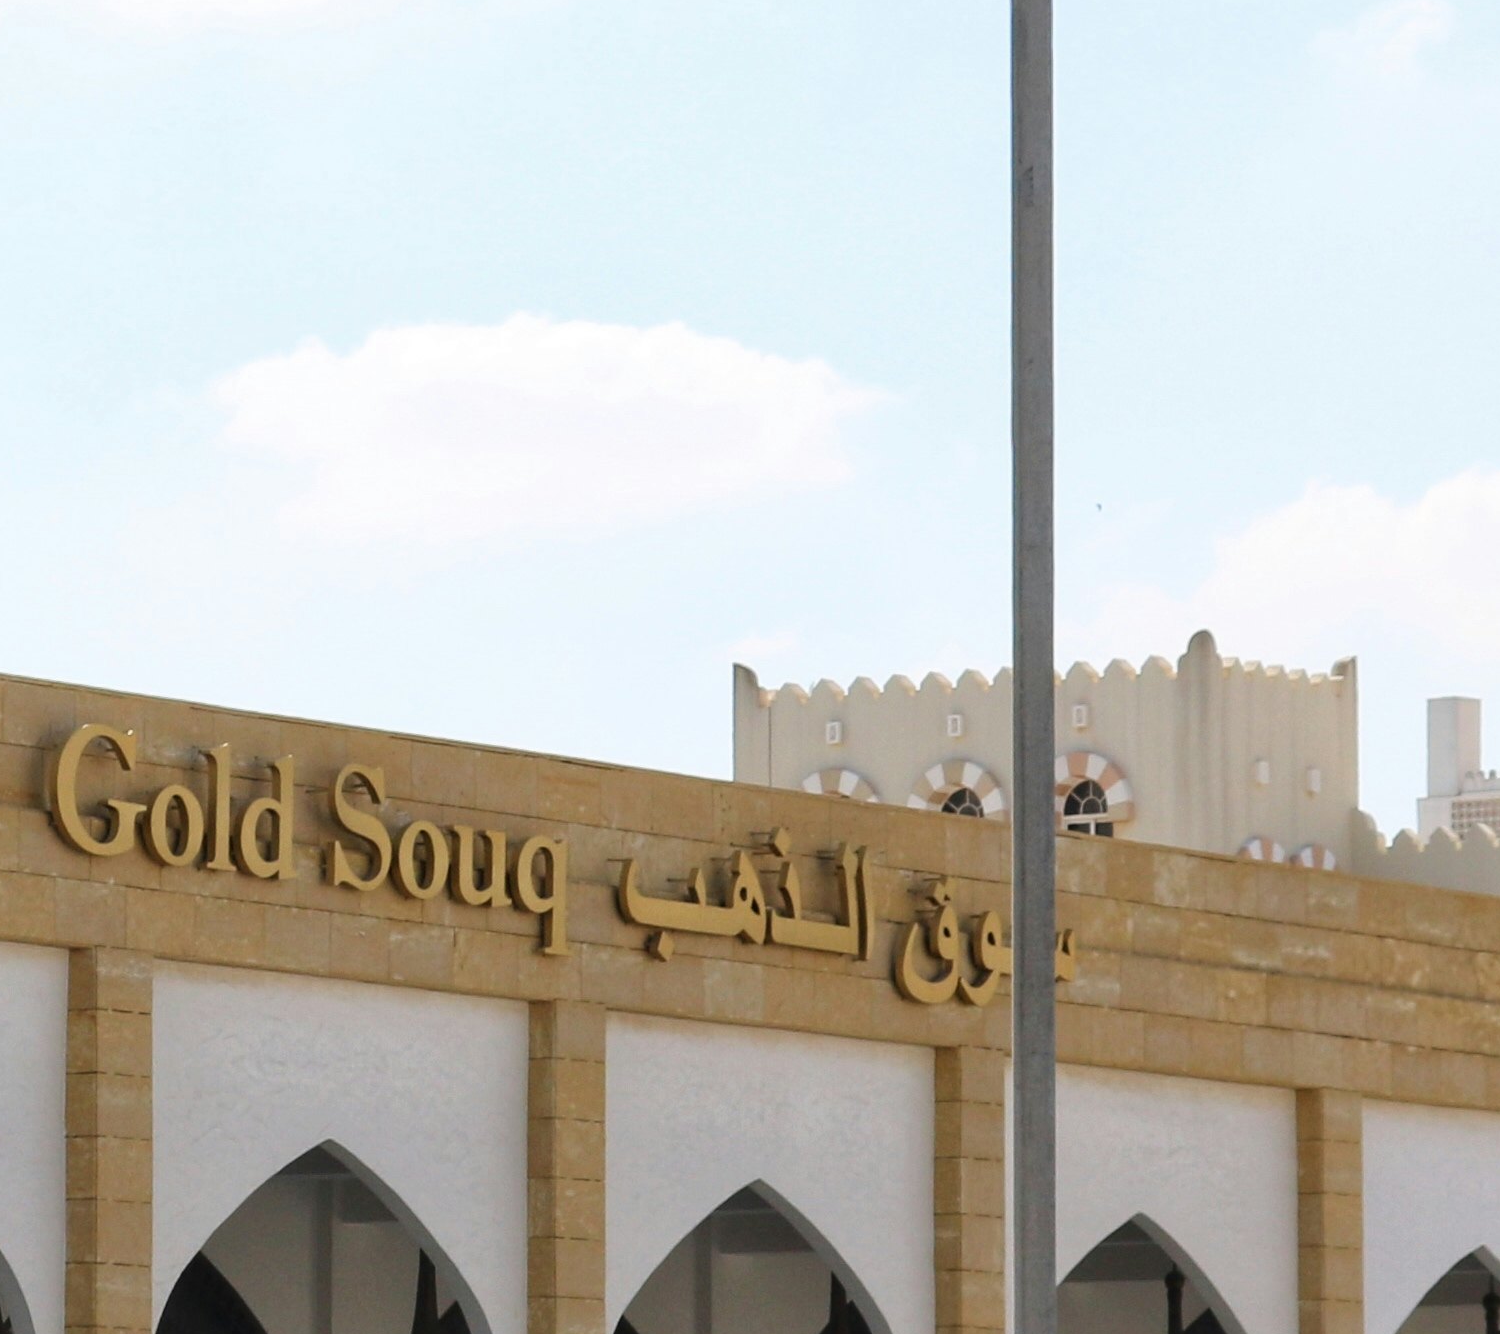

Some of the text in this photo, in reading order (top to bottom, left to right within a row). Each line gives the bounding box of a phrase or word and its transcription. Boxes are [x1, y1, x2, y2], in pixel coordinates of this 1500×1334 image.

[53, 723, 571, 957] Gold Souq
[616, 826, 874, 963] الذهب
